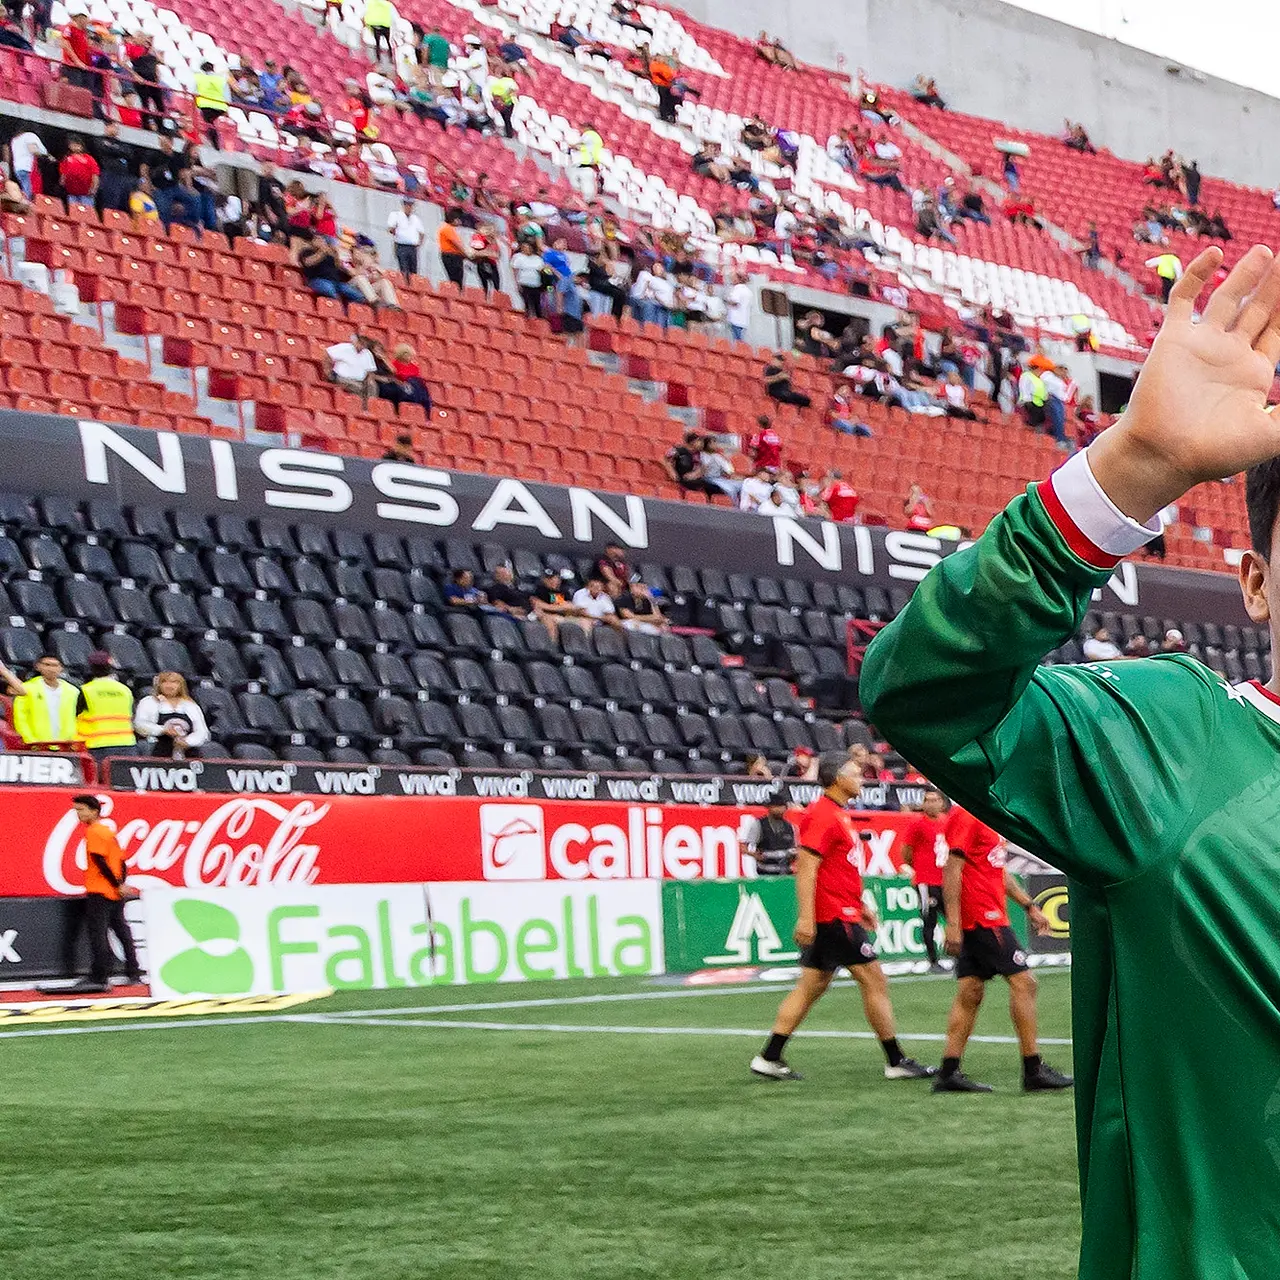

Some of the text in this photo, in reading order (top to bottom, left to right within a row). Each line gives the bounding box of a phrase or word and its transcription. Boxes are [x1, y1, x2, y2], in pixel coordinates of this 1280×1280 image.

[79, 420, 649, 549] NISSAN
[773, 515, 1140, 606] NISN
[267, 894, 653, 991] Falabella
